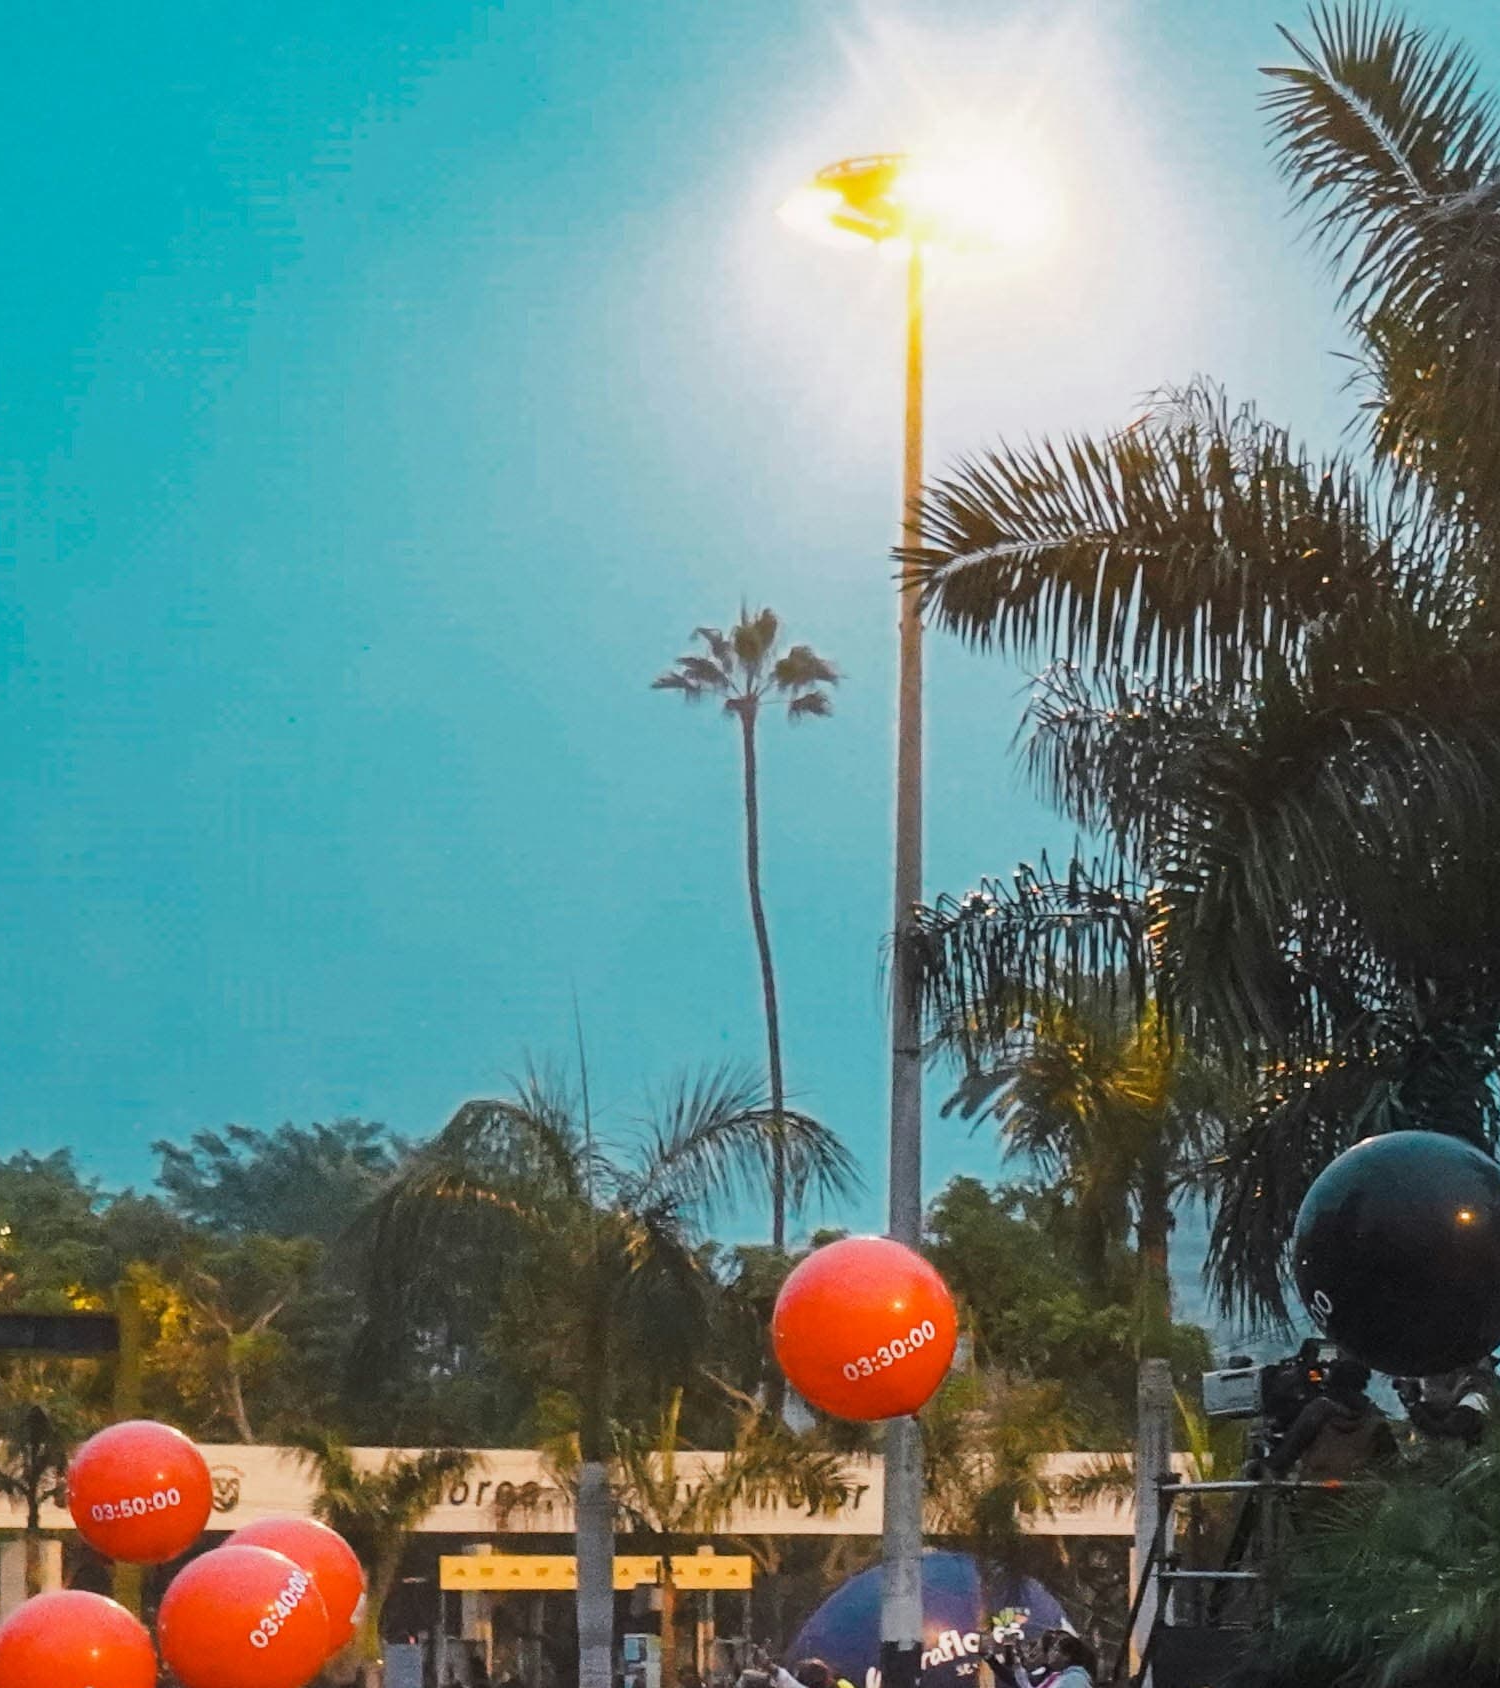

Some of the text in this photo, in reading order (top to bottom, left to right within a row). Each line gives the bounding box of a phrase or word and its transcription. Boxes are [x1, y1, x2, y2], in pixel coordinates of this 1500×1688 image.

[843, 1320, 935, 1381] 03:30:00
[91, 1488, 180, 1521] 03:50:00
[249, 1570, 308, 1648] 03:40:00
